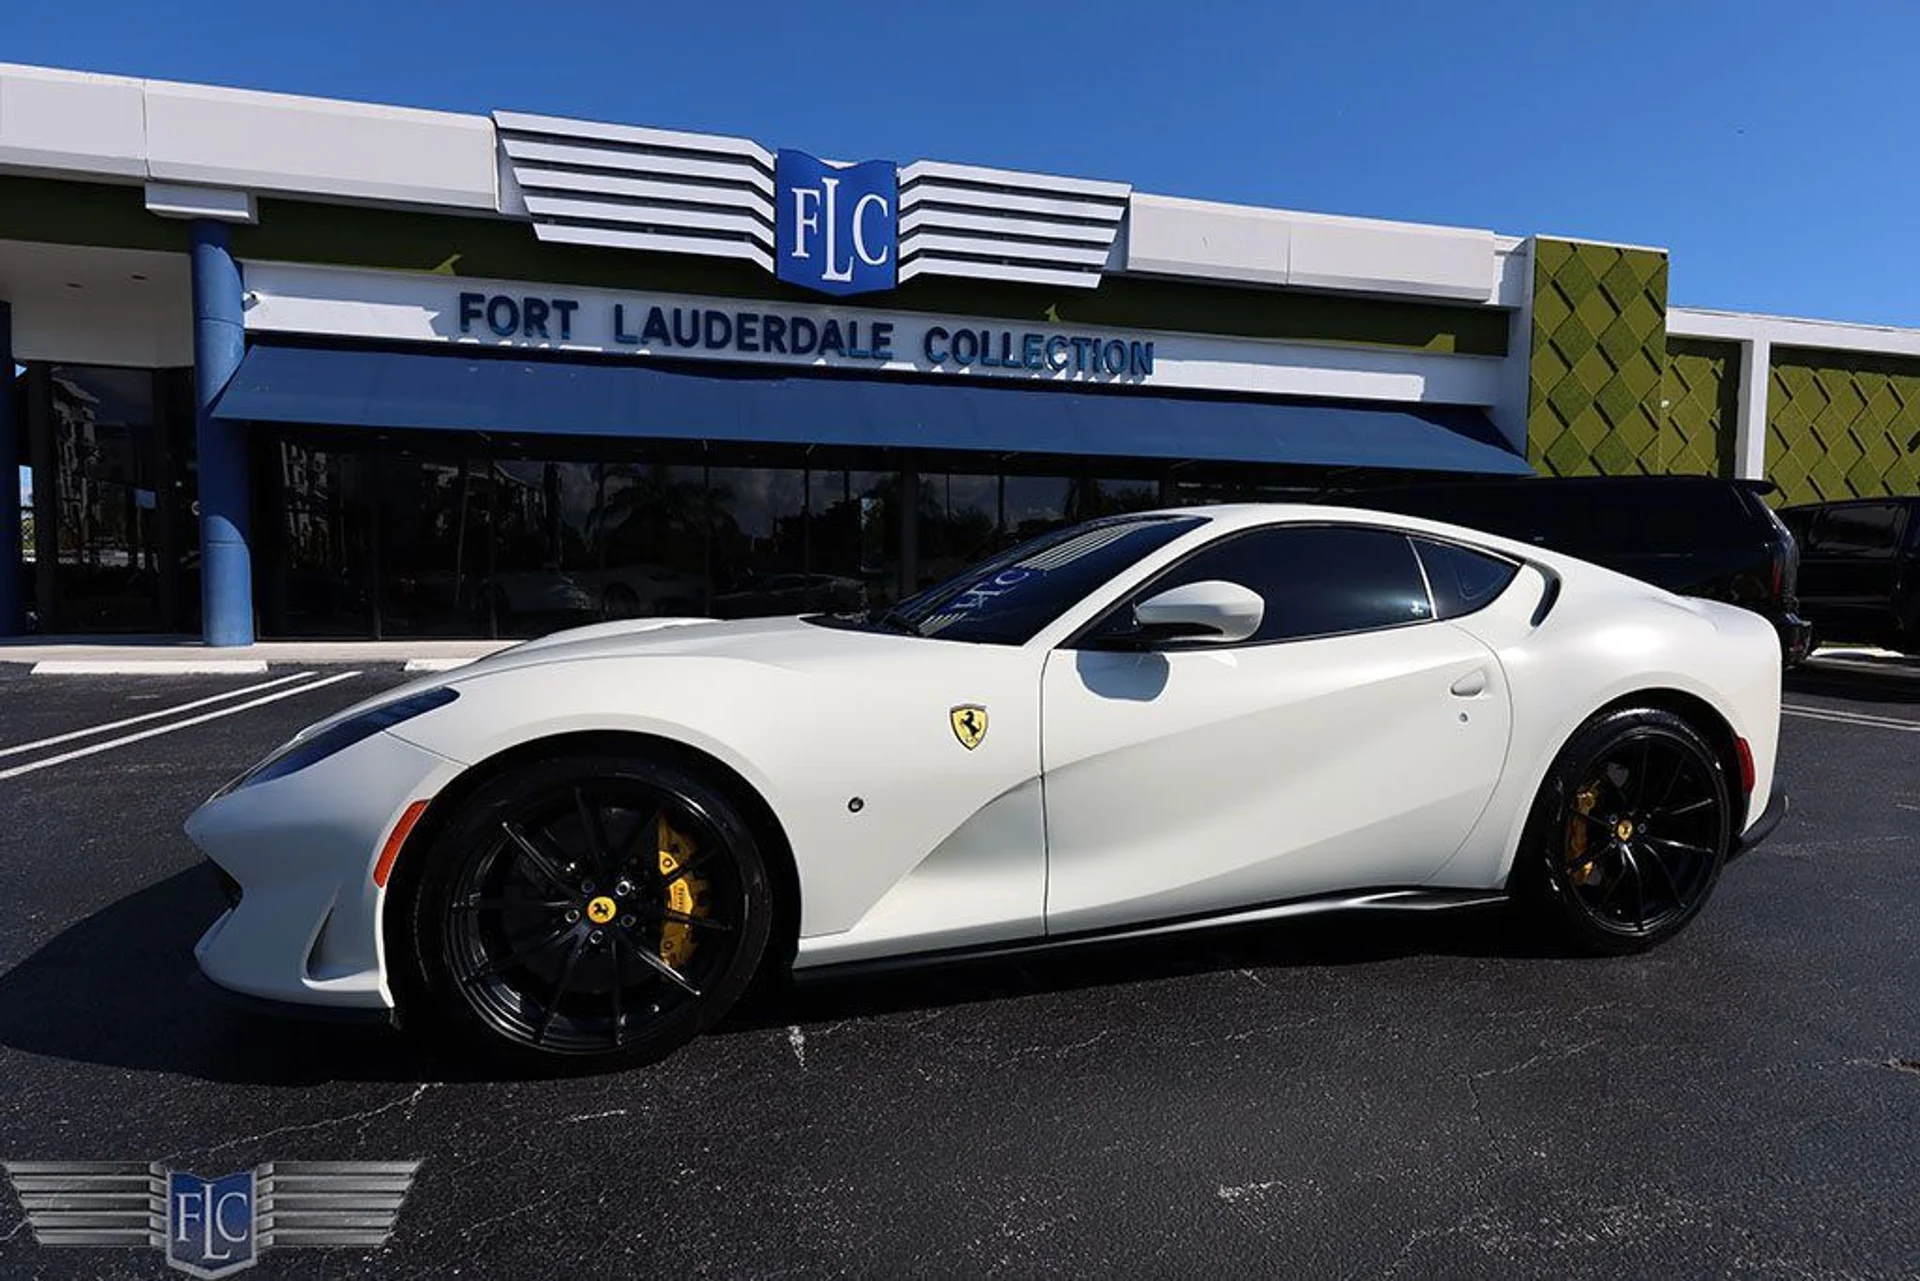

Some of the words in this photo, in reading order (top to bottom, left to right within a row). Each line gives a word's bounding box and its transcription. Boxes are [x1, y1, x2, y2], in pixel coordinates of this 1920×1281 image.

[791, 177, 888, 282] FLC
[459, 292, 579, 340] FORT
[614, 304, 894, 360] LAUDERDALE
[924, 326, 1155, 376] COLLECTION
